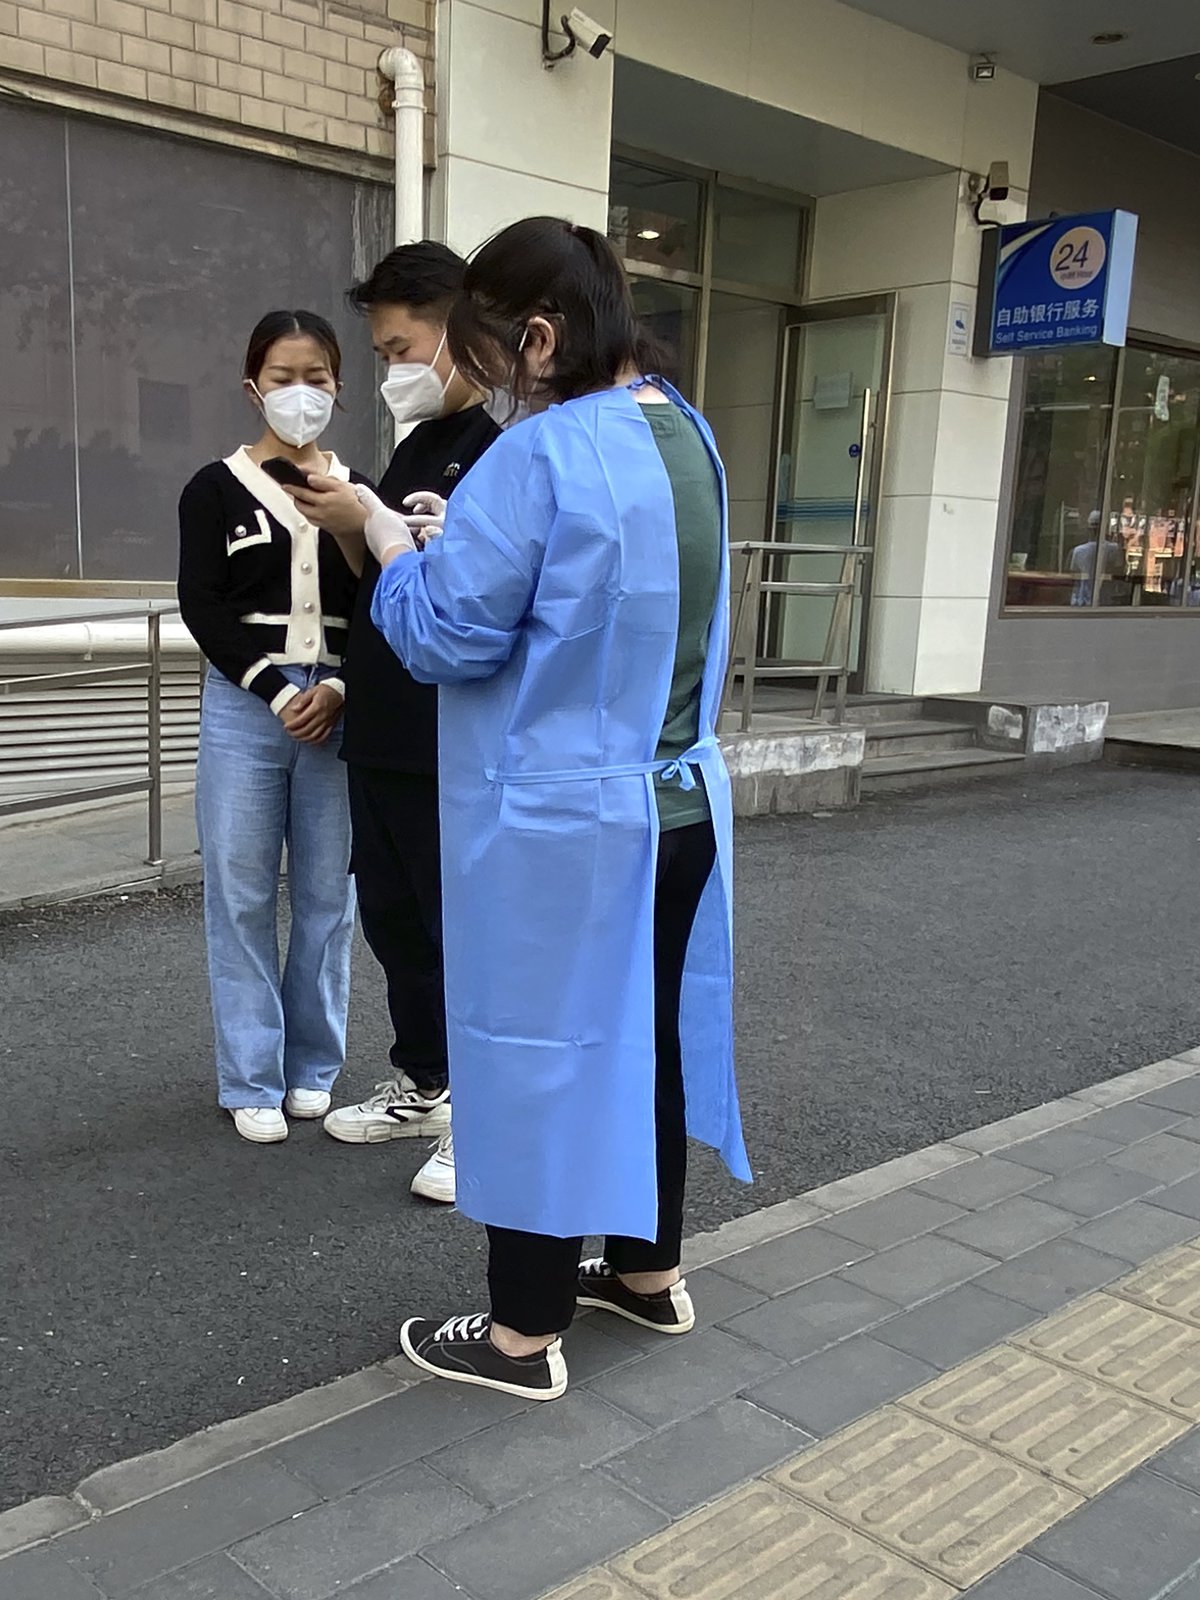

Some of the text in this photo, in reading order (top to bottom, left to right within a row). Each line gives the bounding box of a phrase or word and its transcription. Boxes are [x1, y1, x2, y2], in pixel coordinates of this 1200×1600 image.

[1055, 240, 1089, 272] 24
[997, 298, 1099, 327] 自助银行服务
[1017, 330, 1053, 341] Service
[1056, 326, 1097, 338] Banking
